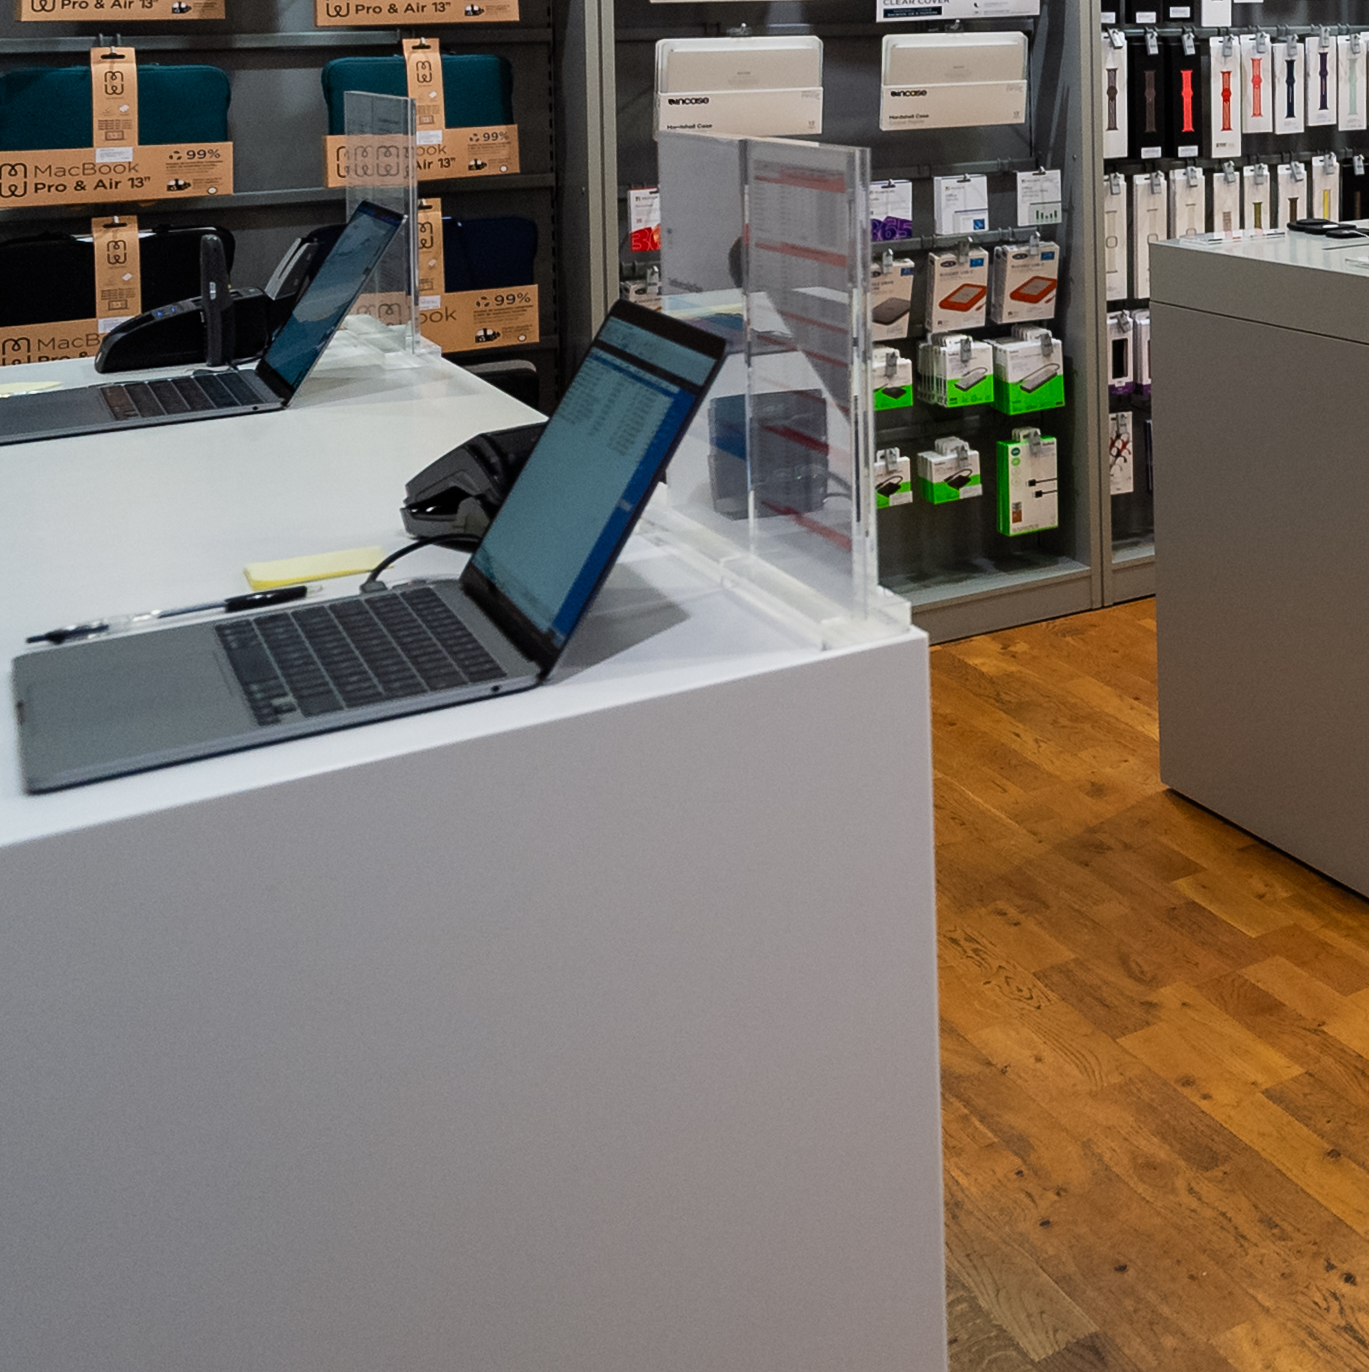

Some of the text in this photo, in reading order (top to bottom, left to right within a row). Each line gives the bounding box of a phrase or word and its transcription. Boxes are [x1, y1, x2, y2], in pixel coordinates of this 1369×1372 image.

[355, 4, 383, 15] Pro
[388, 3, 398, 14] &
[404, 2, 427, 13] Air
[482, 131, 509, 142] 99%
[186, 149, 220, 160] 99%
[34, 161, 139, 178] MacBook
[34, 181, 67, 194] Pro
[74, 180, 87, 191] &
[94, 179, 120, 190] Air
[494, 292, 532, 307] 99%
[37, 332, 101, 352] MacB
